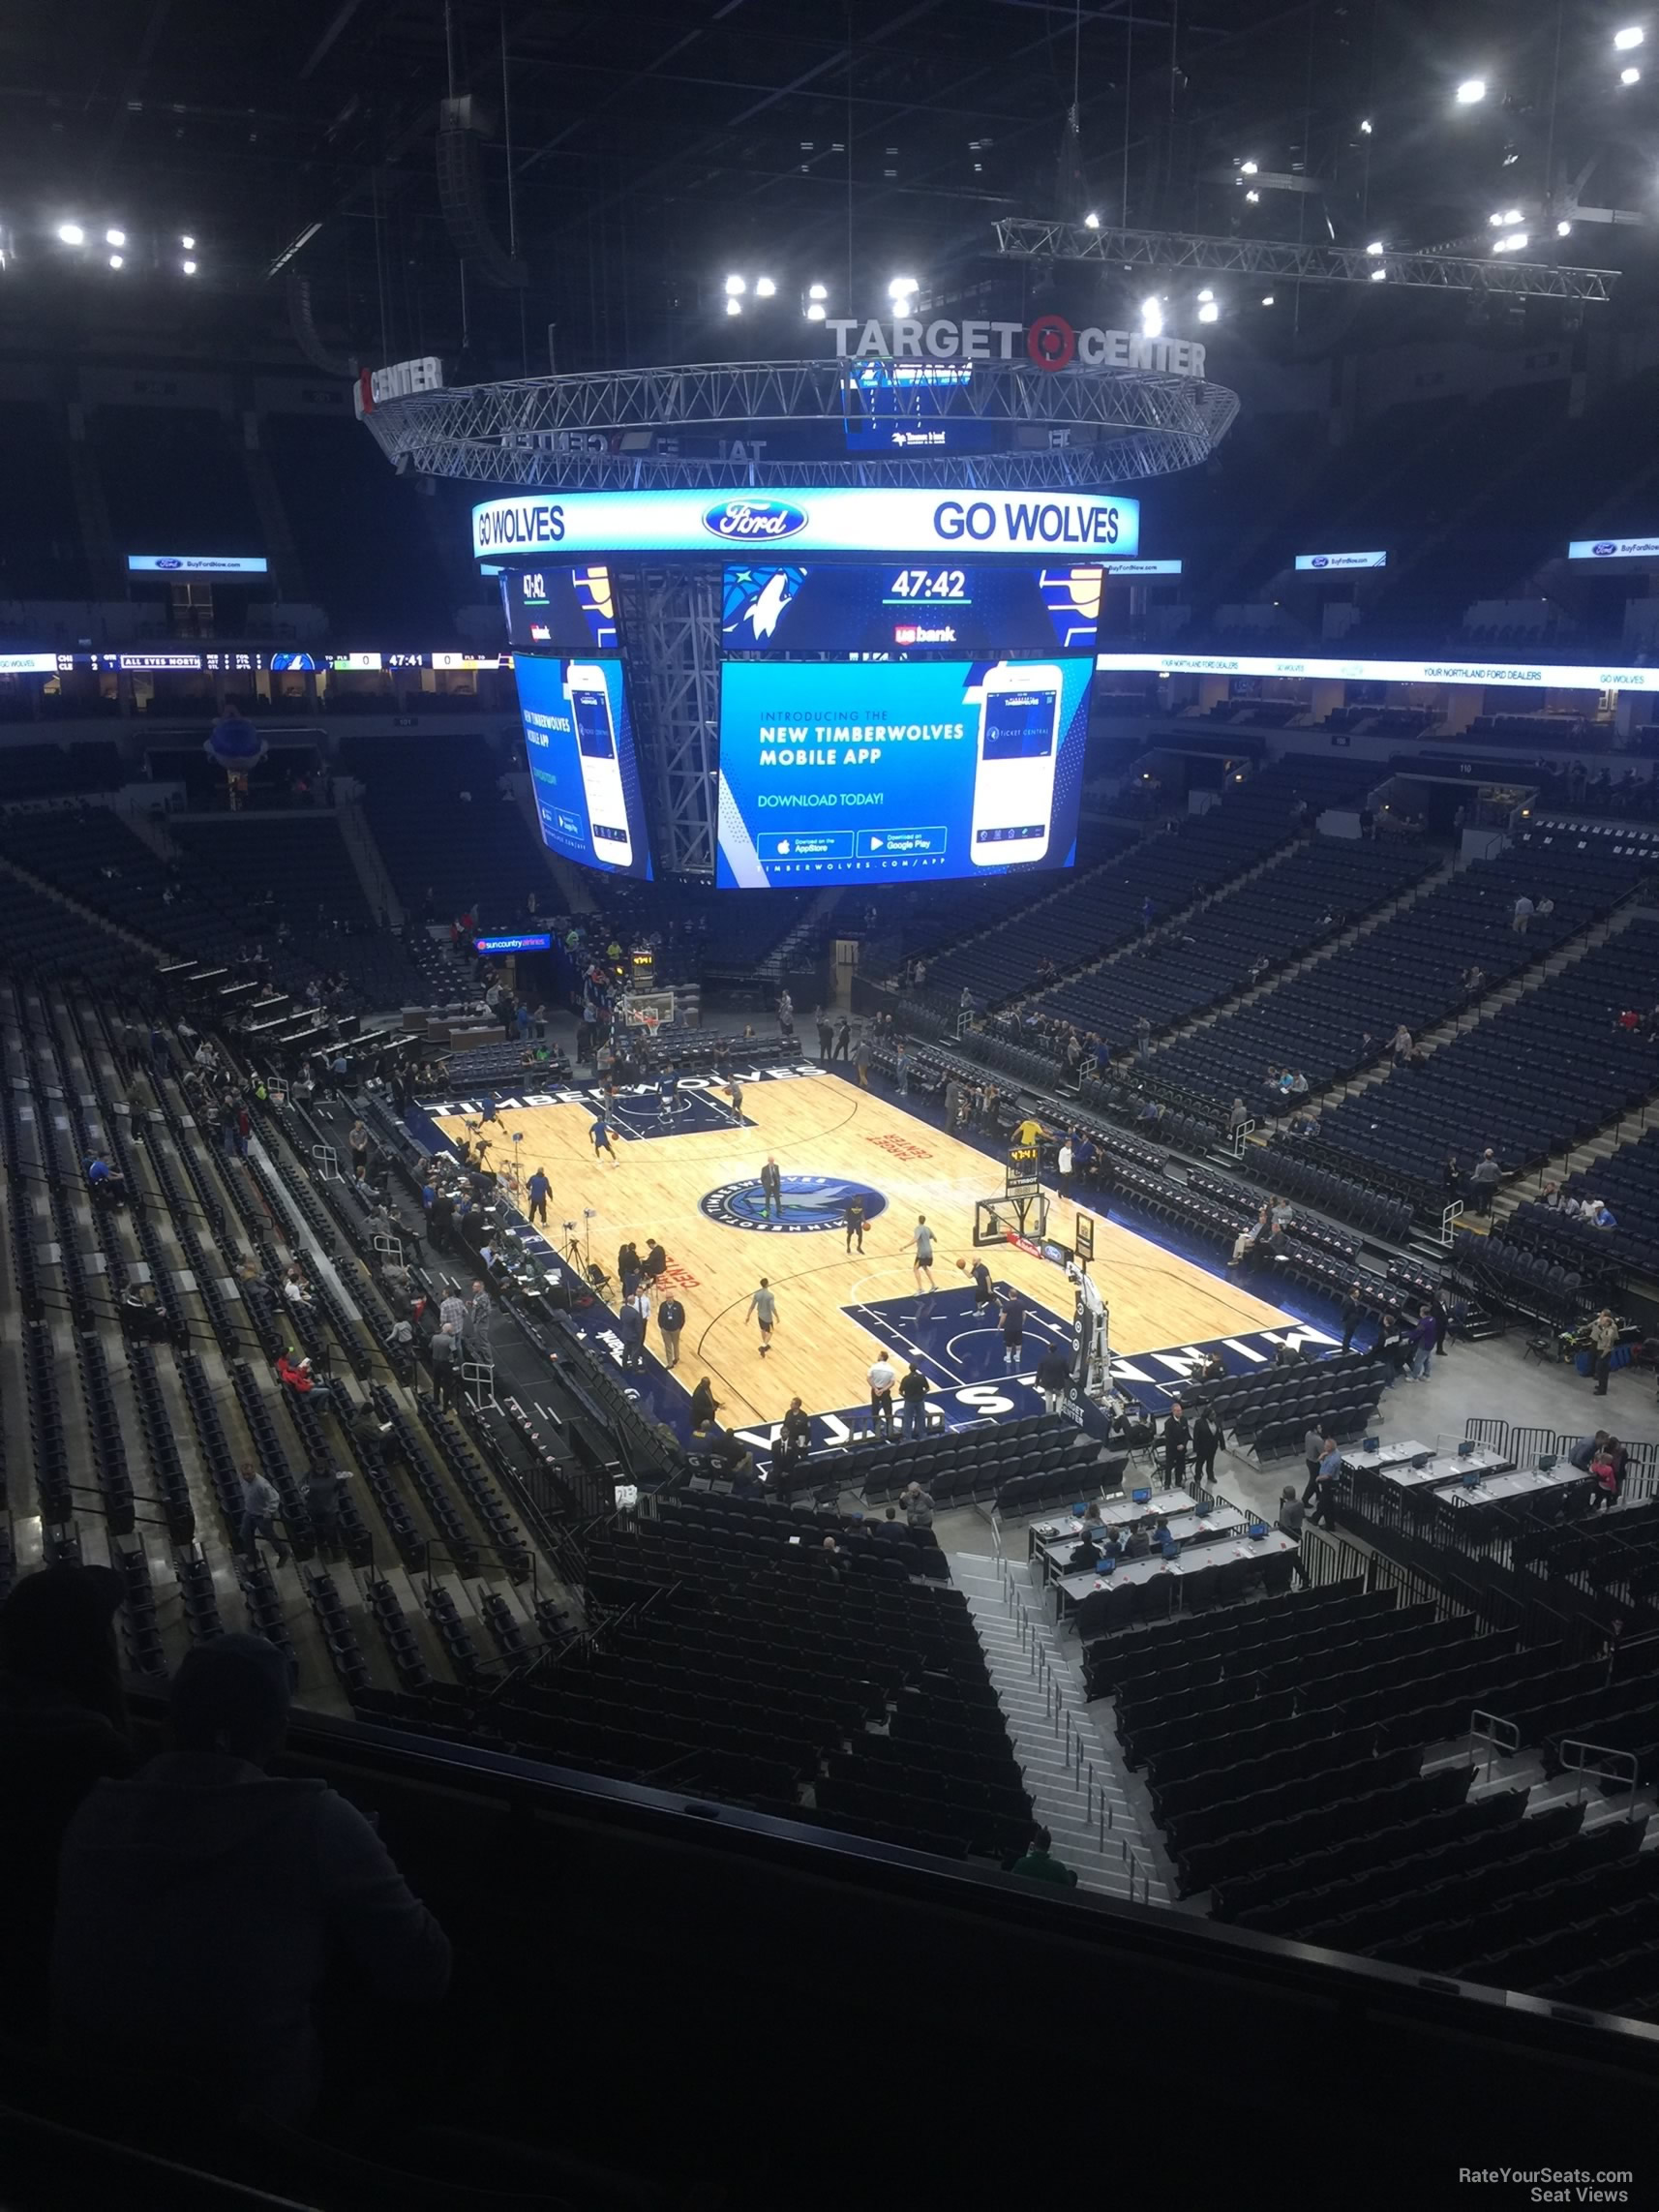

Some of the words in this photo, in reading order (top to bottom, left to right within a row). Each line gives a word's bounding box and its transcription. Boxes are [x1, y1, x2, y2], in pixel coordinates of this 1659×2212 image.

[825, 318, 1022, 359] TARGET
[1077, 327, 1207, 378] CENTER
[372, 356, 442, 404] CENTER
[719, 500, 788, 534] Ford
[934, 501, 996, 540] GO
[1005, 503, 1119, 543] WOLVES
[479, 514, 491, 546] GO
[493, 505, 564, 543] WOLVES
[891, 569, 965, 597] 47:42
[363, 655, 370, 665] 0
[389, 654, 423, 666] 47:41
[444, 655, 451, 665] 0
[1424, 667, 1442, 677] YOUR
[1443, 668, 1485, 679] NORTHLAND
[1486, 669, 1506, 679] FORD
[1507, 670, 1542, 681] DEALERS
[1600, 674, 1611, 682] GO
[1613, 675, 1644, 684] WOLVES
[760, 711, 861, 722] INTRODUCING
[864, 711, 889, 721] THE
[760, 726, 809, 743] NEW
[815, 723, 964, 742] TIMBERWOLVES
[759, 748, 837, 766] MOBILE
[843, 748, 882, 764] APP
[1460, 764, 1472, 773] 110
[758, 794, 837, 807] DOWNLOAD
[839, 793, 884, 805] TODAY!
[887, 840, 913, 851] Google
[915, 840, 931, 850] Play
[884, 1134, 933, 1160] CENTER
[1010, 1149, 1038, 1160] 47:41
[688, 1456, 700, 1467] G
[710, 1459, 722, 1469] G
